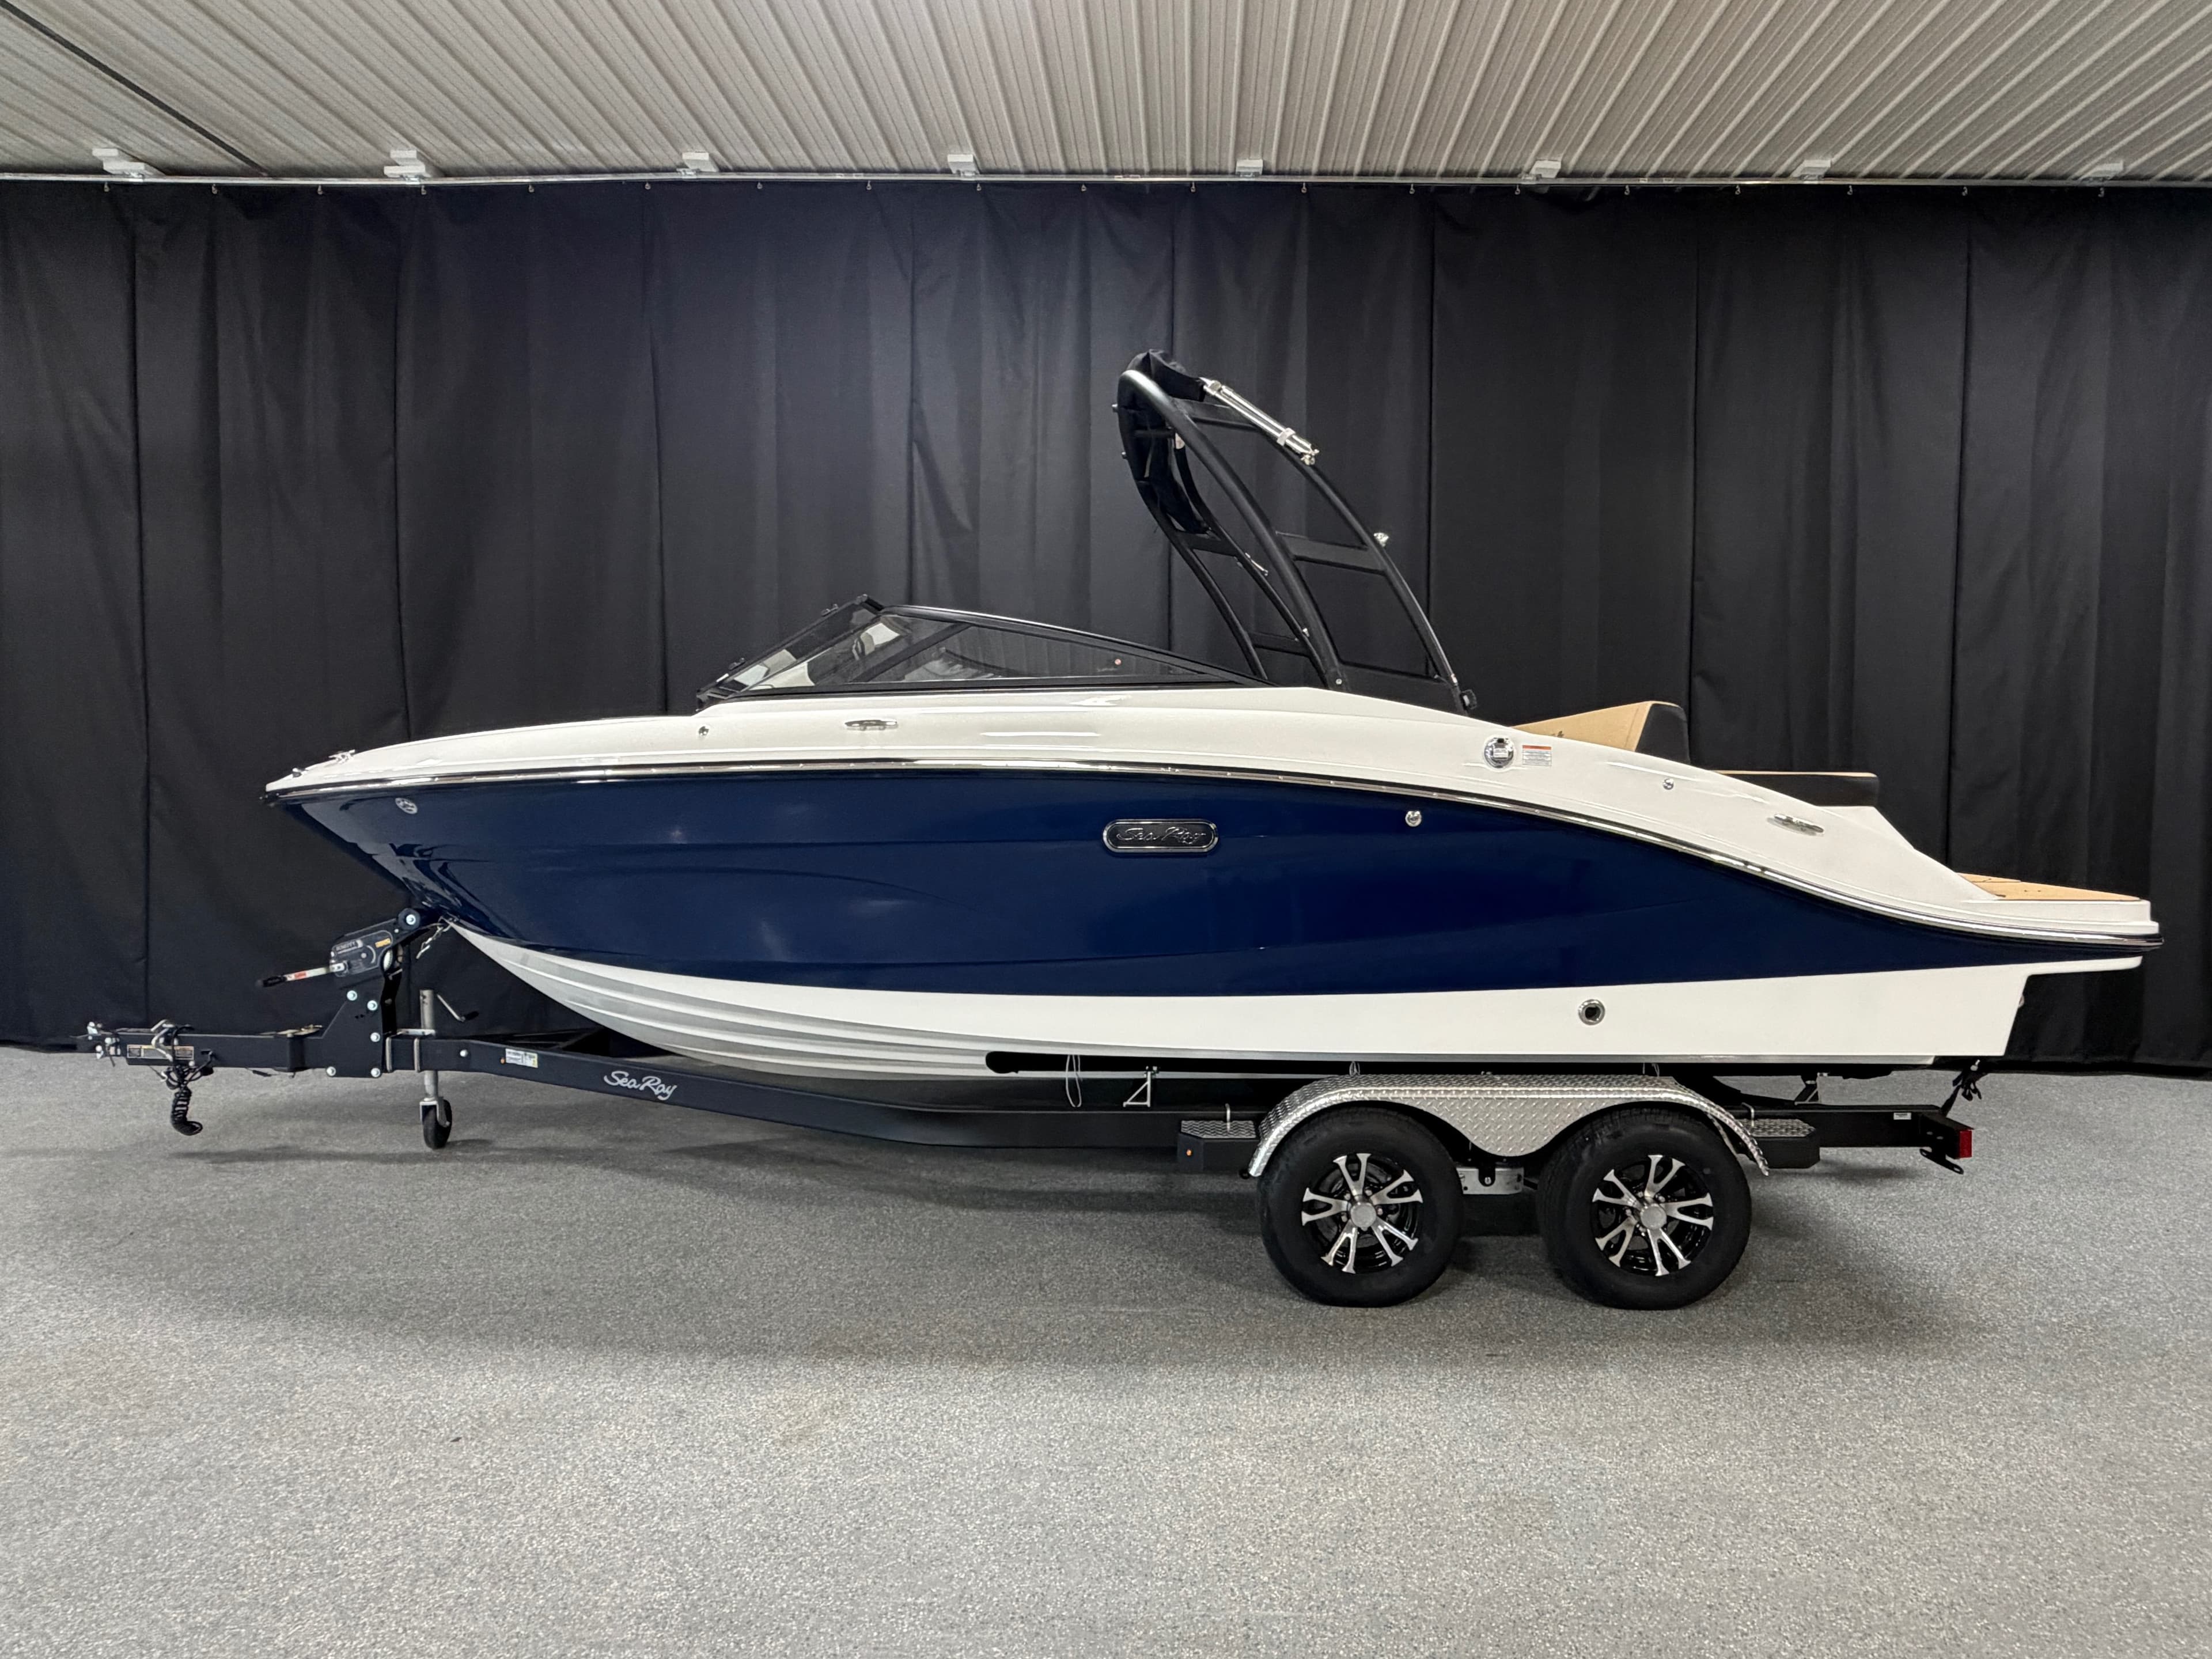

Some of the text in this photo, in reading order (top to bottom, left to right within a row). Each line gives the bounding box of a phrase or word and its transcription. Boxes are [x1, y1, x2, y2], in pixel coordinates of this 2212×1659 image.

[1116, 828, 1160, 840] Sea
[603, 1071, 677, 1100] Sea Ray
